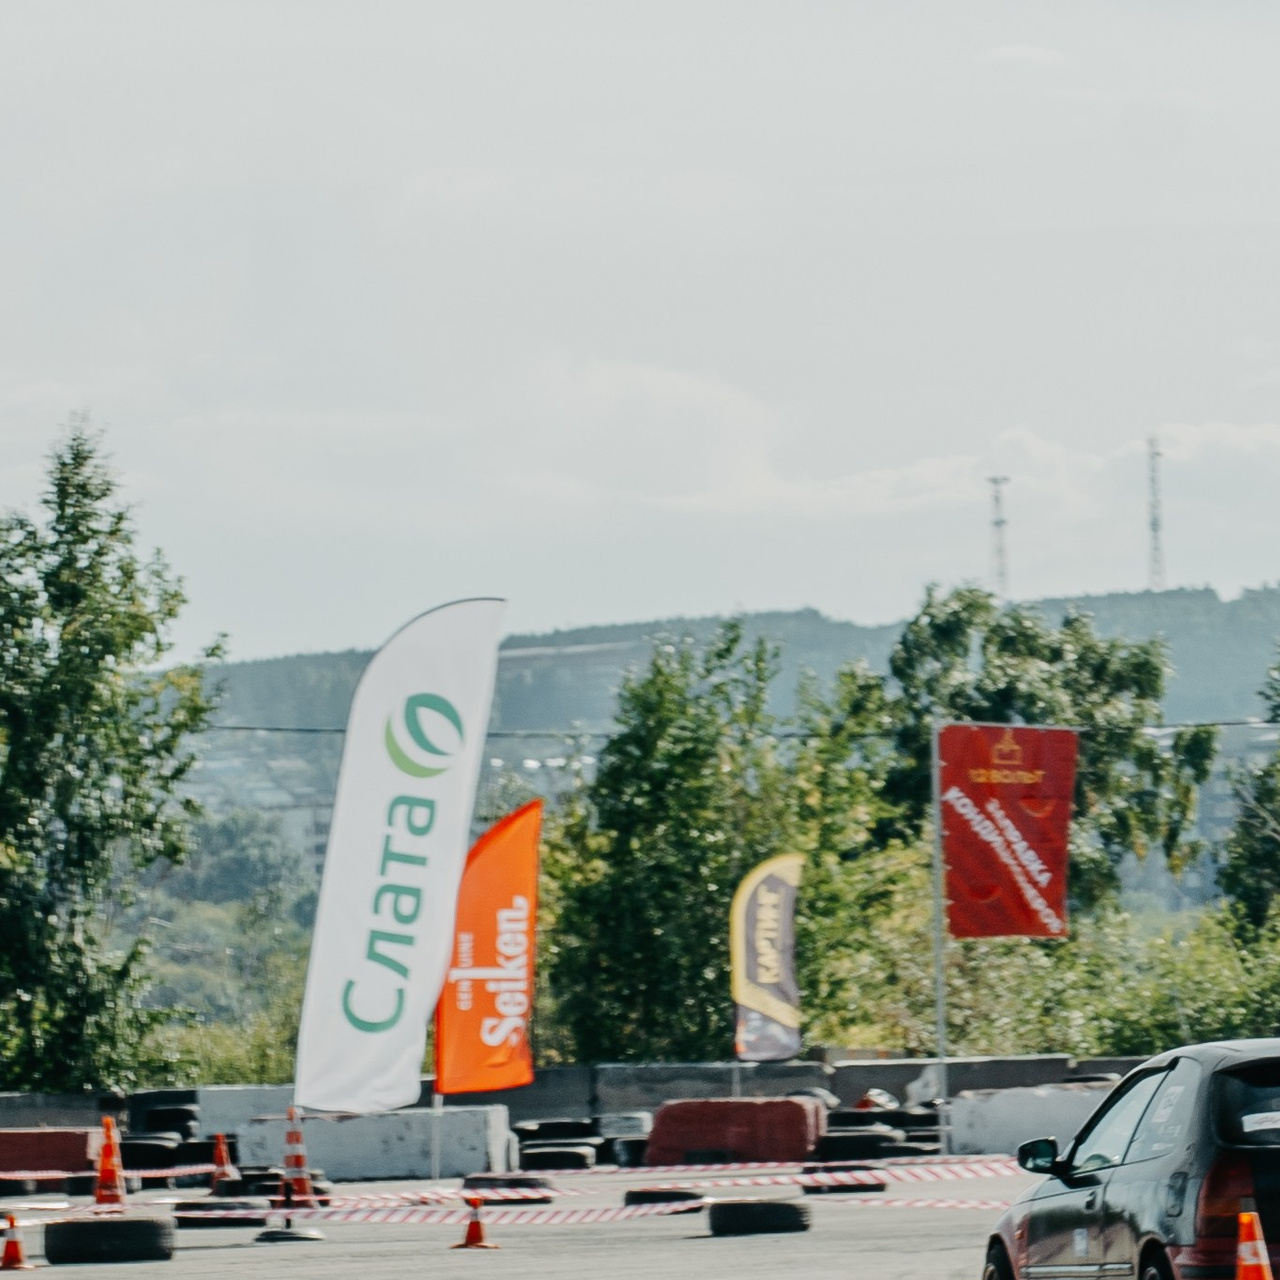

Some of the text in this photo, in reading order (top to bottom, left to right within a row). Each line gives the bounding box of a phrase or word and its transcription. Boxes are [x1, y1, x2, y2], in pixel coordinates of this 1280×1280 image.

[341, 795, 437, 1034] Слата
[448, 895, 529, 1047] Seiken
[755, 884, 782, 984] КАРТИНГ
